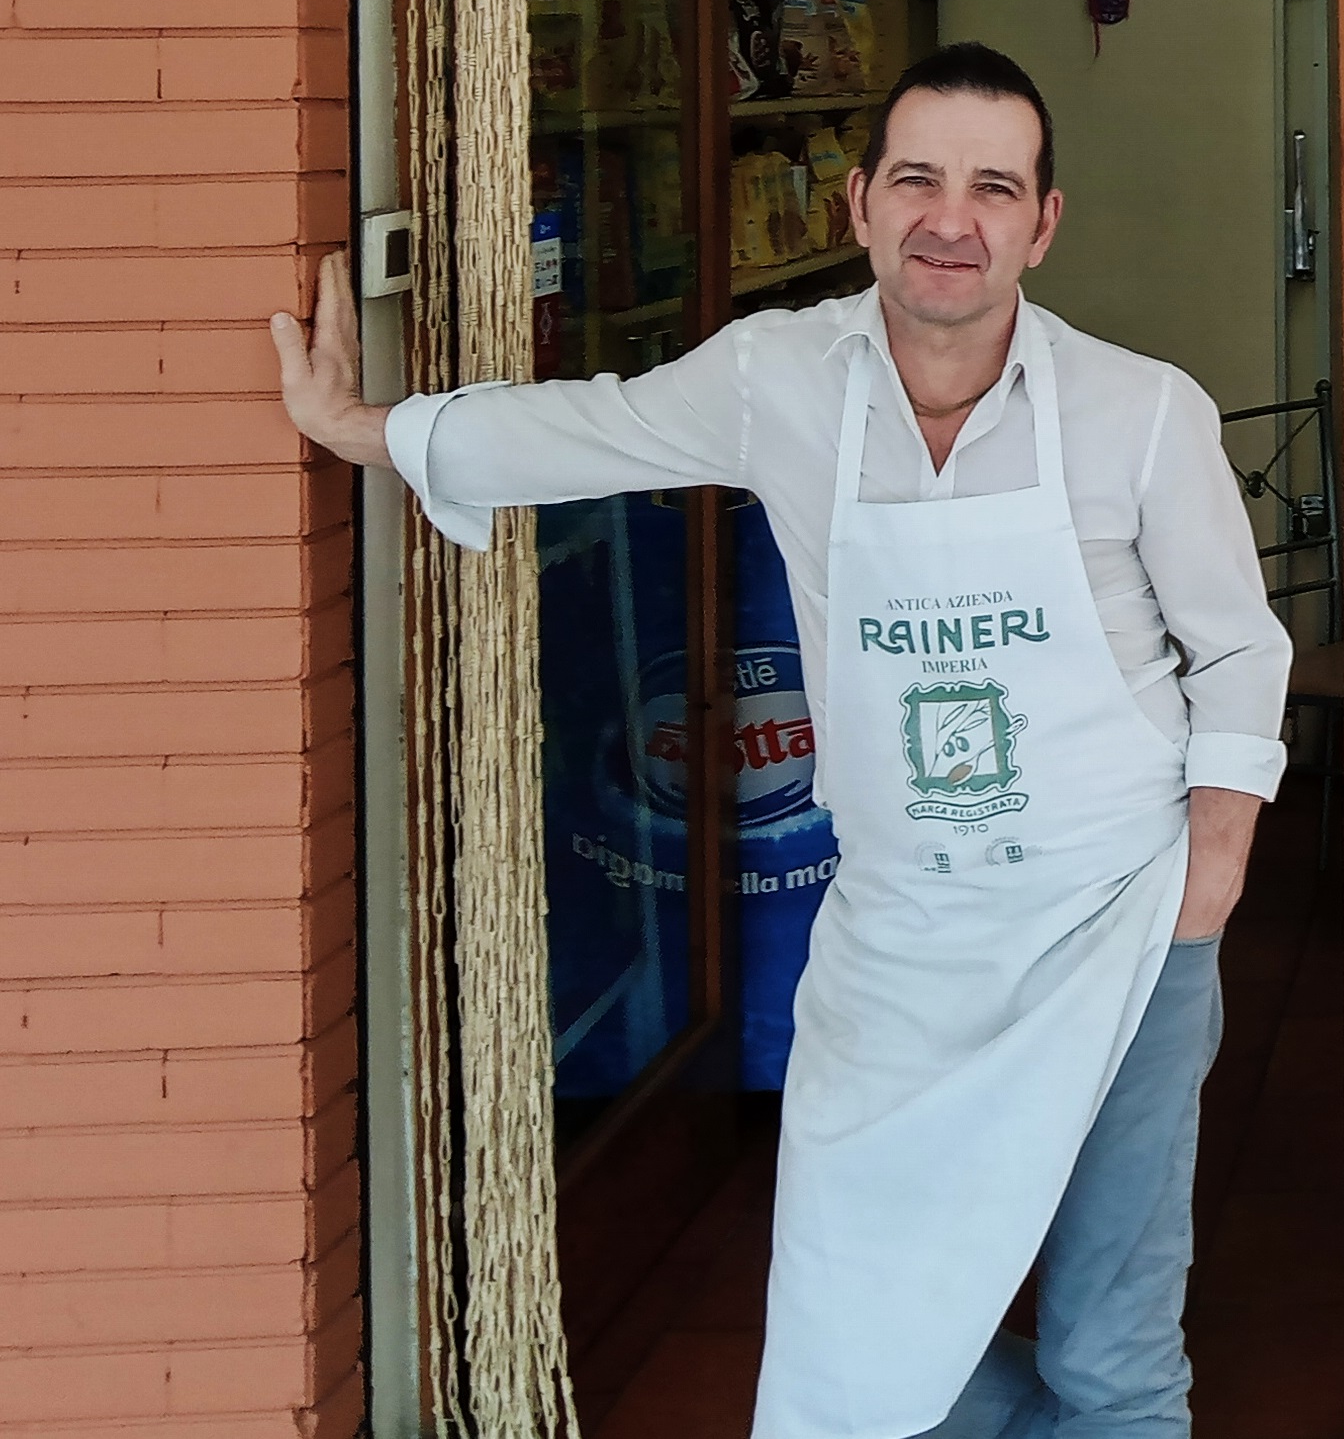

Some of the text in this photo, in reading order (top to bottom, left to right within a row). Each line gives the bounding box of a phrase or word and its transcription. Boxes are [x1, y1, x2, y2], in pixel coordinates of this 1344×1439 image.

[885, 589, 1014, 612] ANTICA AZIENDA
[858, 606, 1050, 655] RAINERI
[921, 657, 988, 674] IMPERIA
[949, 797, 1021, 817] REGISTRATA
[952, 823, 990, 837] 1910
